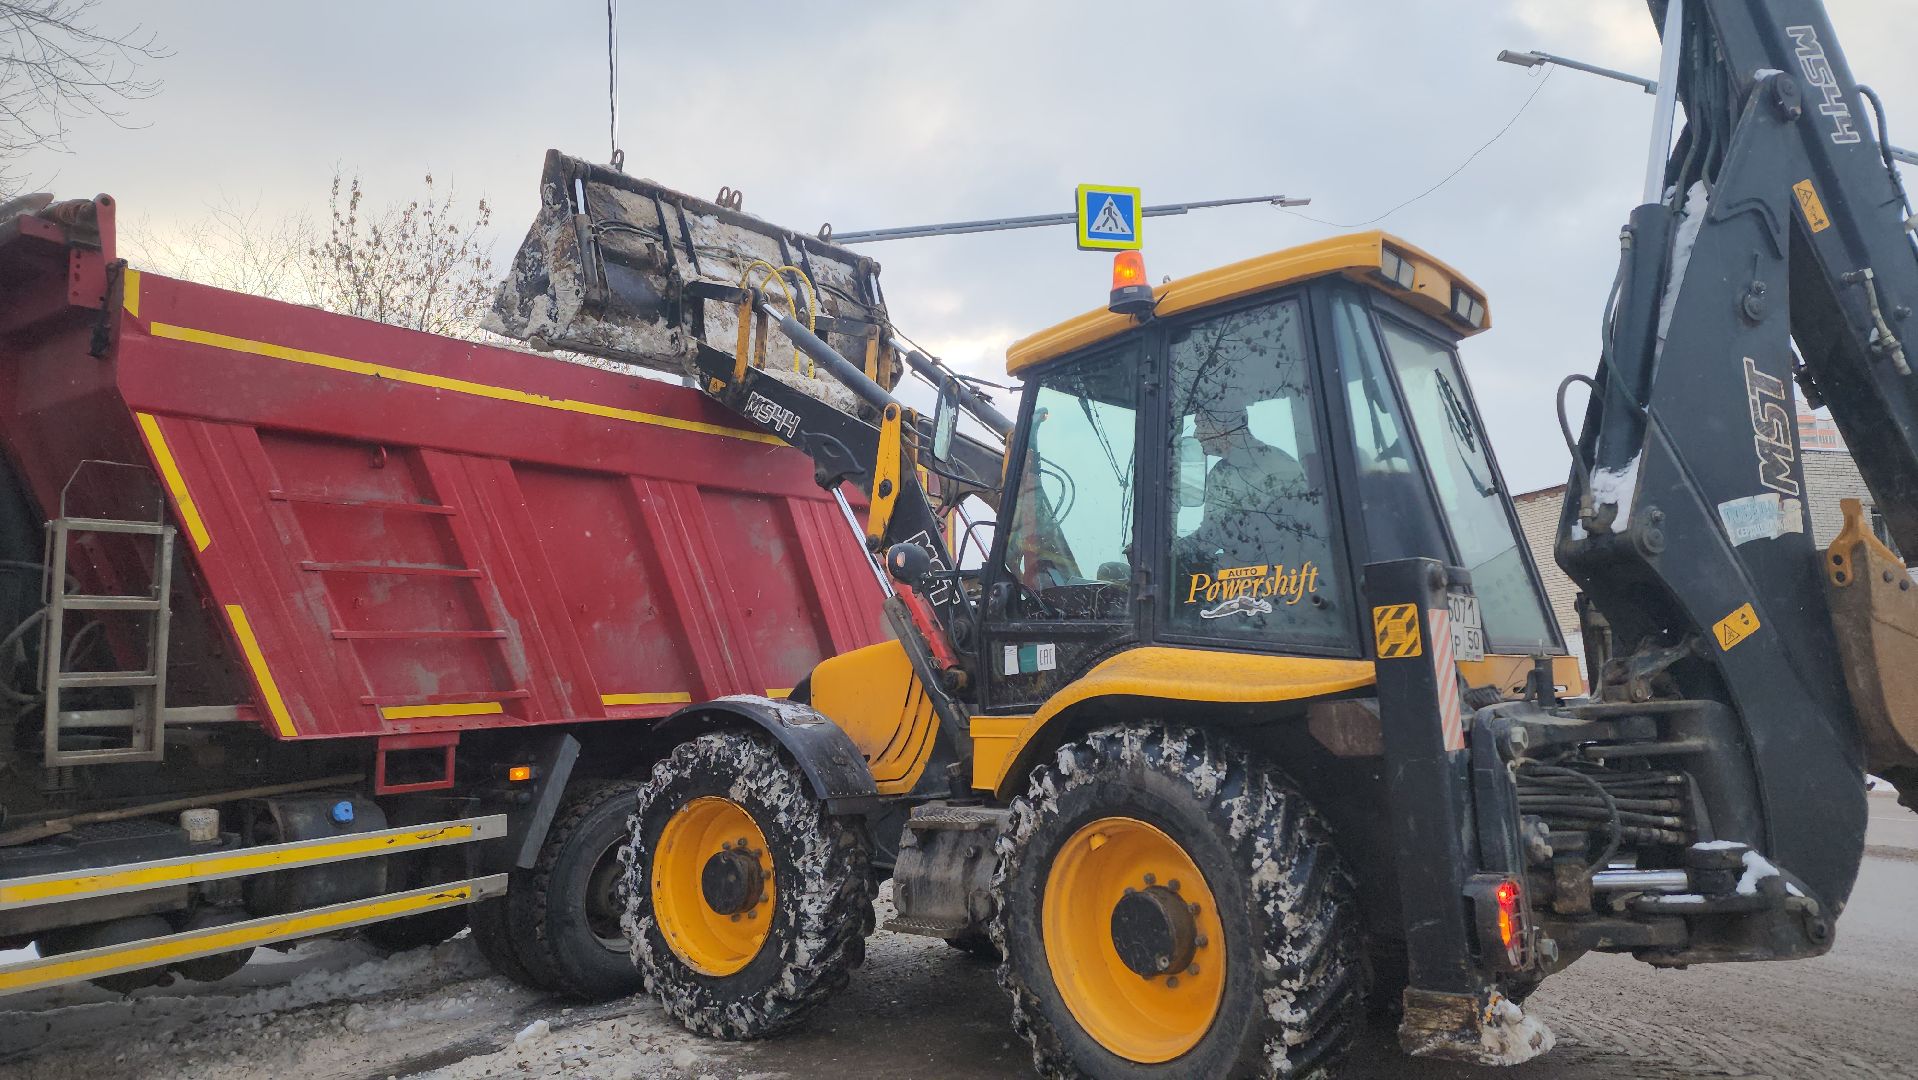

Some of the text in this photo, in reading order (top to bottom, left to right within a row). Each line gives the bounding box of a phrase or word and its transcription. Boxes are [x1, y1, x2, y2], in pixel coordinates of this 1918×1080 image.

[1786, 25, 1861, 144] MS44
[743, 390, 801, 439] MS44
[1743, 356, 1800, 497] MST
[1183, 560, 1319, 605] Powershift
[1227, 567, 1258, 578] AUTO
[1467, 630, 1480, 650] 50
